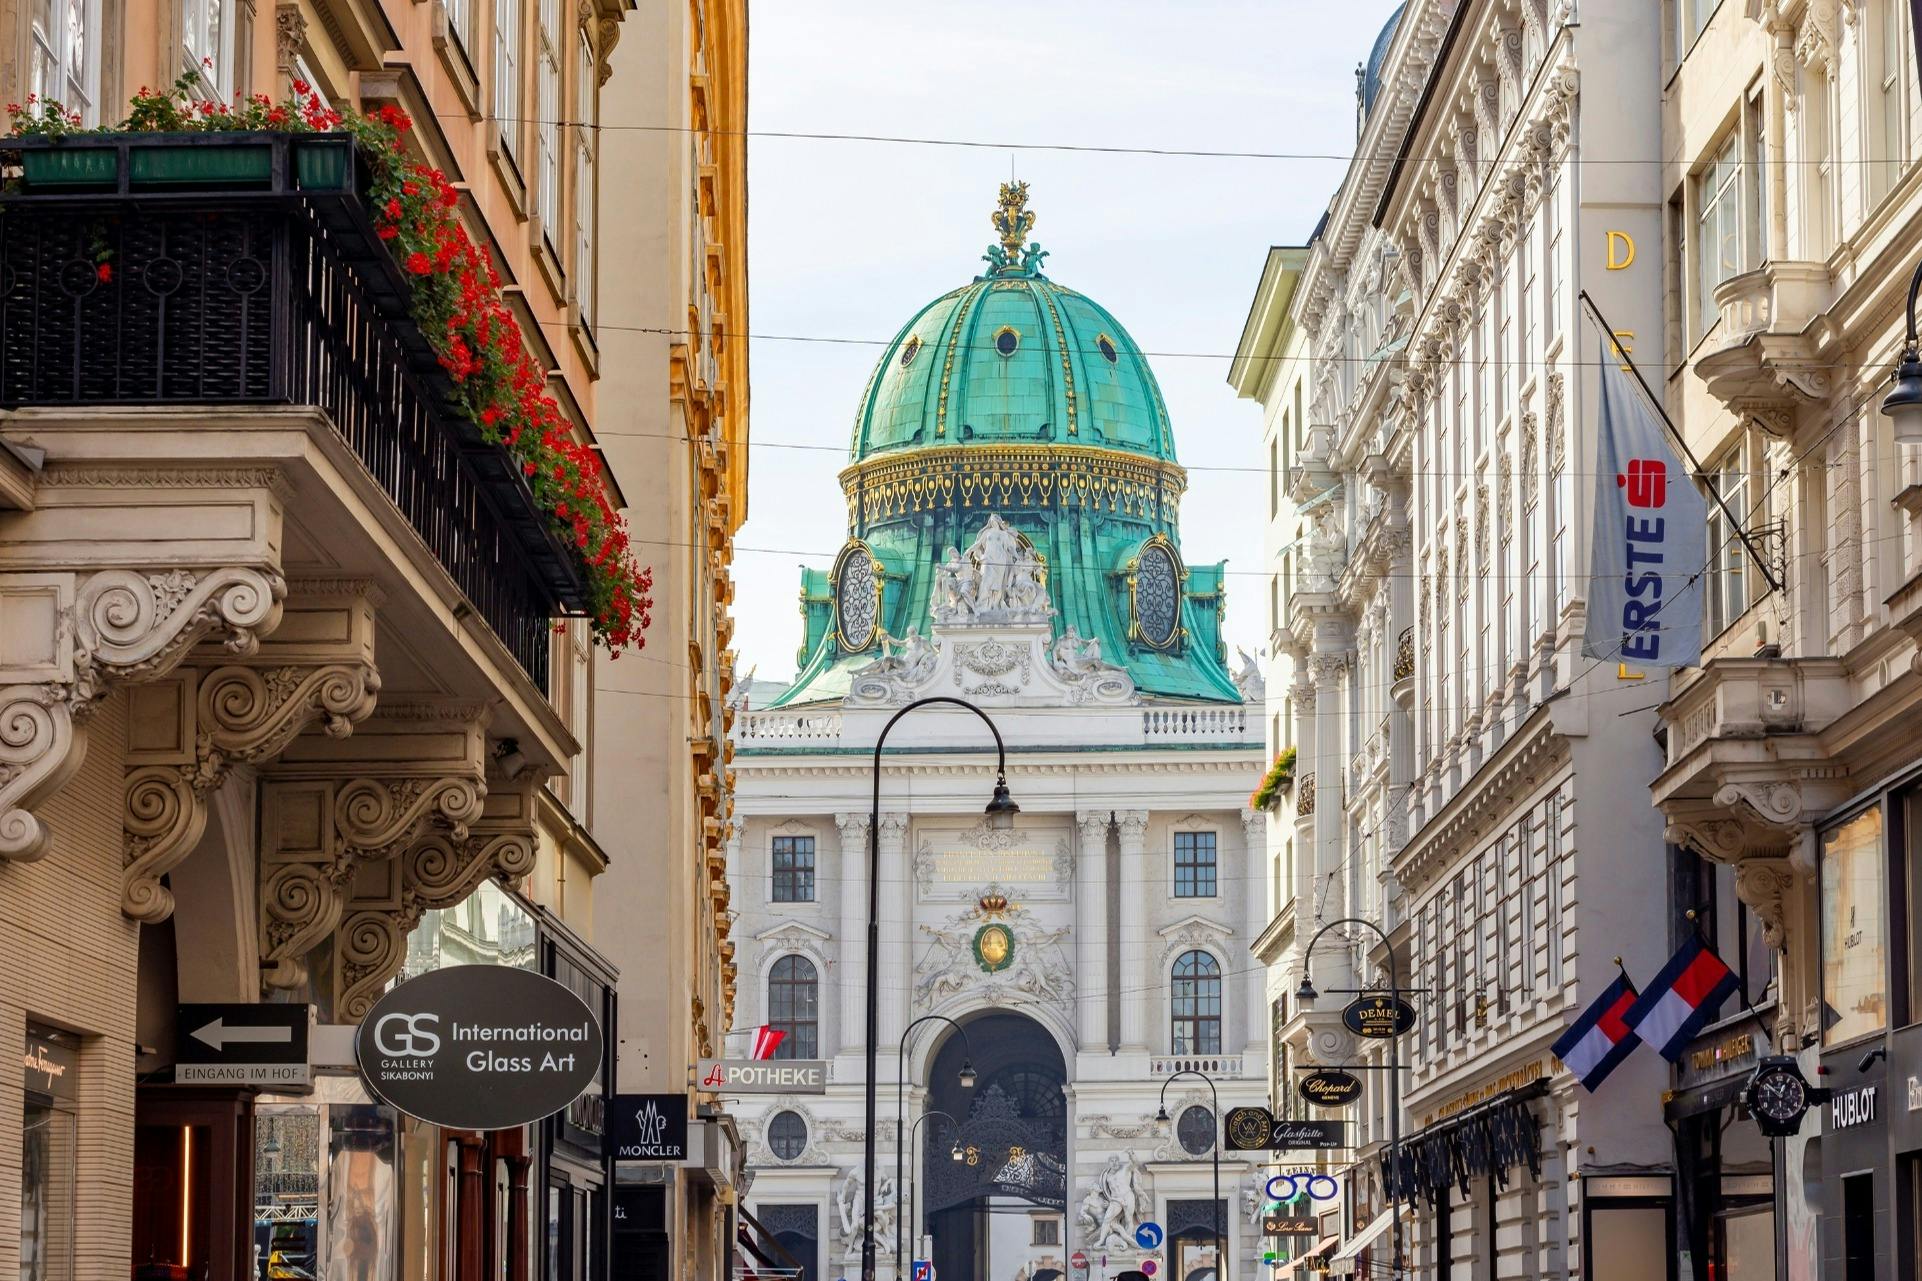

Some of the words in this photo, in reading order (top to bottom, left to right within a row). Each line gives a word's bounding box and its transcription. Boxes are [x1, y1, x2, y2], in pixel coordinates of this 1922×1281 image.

[1620, 515, 1665, 660] ERSTE
[374, 1012, 441, 1057] GS
[452, 1021, 589, 1041] International
[381, 1059, 435, 1069] GALLERY
[466, 1050, 532, 1073] Glass
[539, 1050, 576, 1073] Art
[184, 1068, 245, 1080] EINGANG
[250, 1068, 267, 1080] IM
[272, 1068, 299, 1080] HOF
[380, 1071, 434, 1081] SIKABONYI
[703, 1064, 820, 1087] APOTHEKE
[1305, 1078, 1356, 1096] Chopard
[1832, 1086, 1876, 1130] HUBLOT
[619, 1145, 681, 1156] MONCLER
